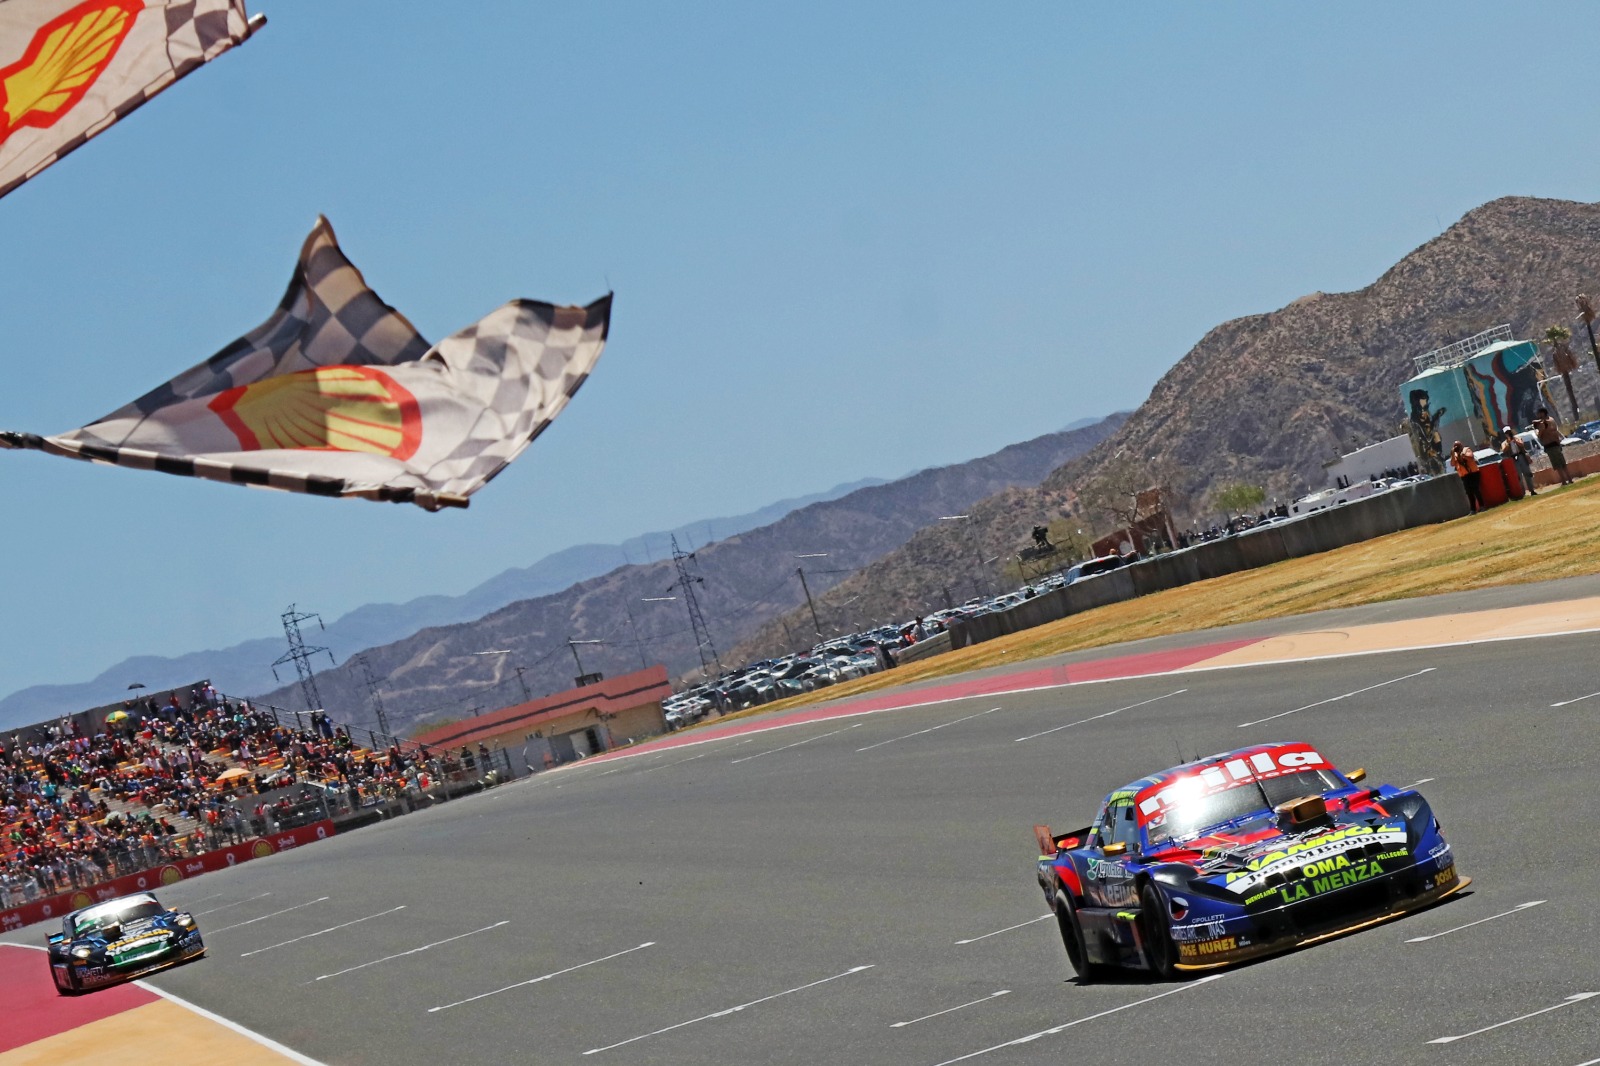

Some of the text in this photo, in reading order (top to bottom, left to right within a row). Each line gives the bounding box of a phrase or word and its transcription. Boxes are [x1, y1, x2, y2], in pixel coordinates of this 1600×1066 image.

[1281, 861, 1385, 904] LA MENZA
[1303, 855, 1351, 878] OMA
